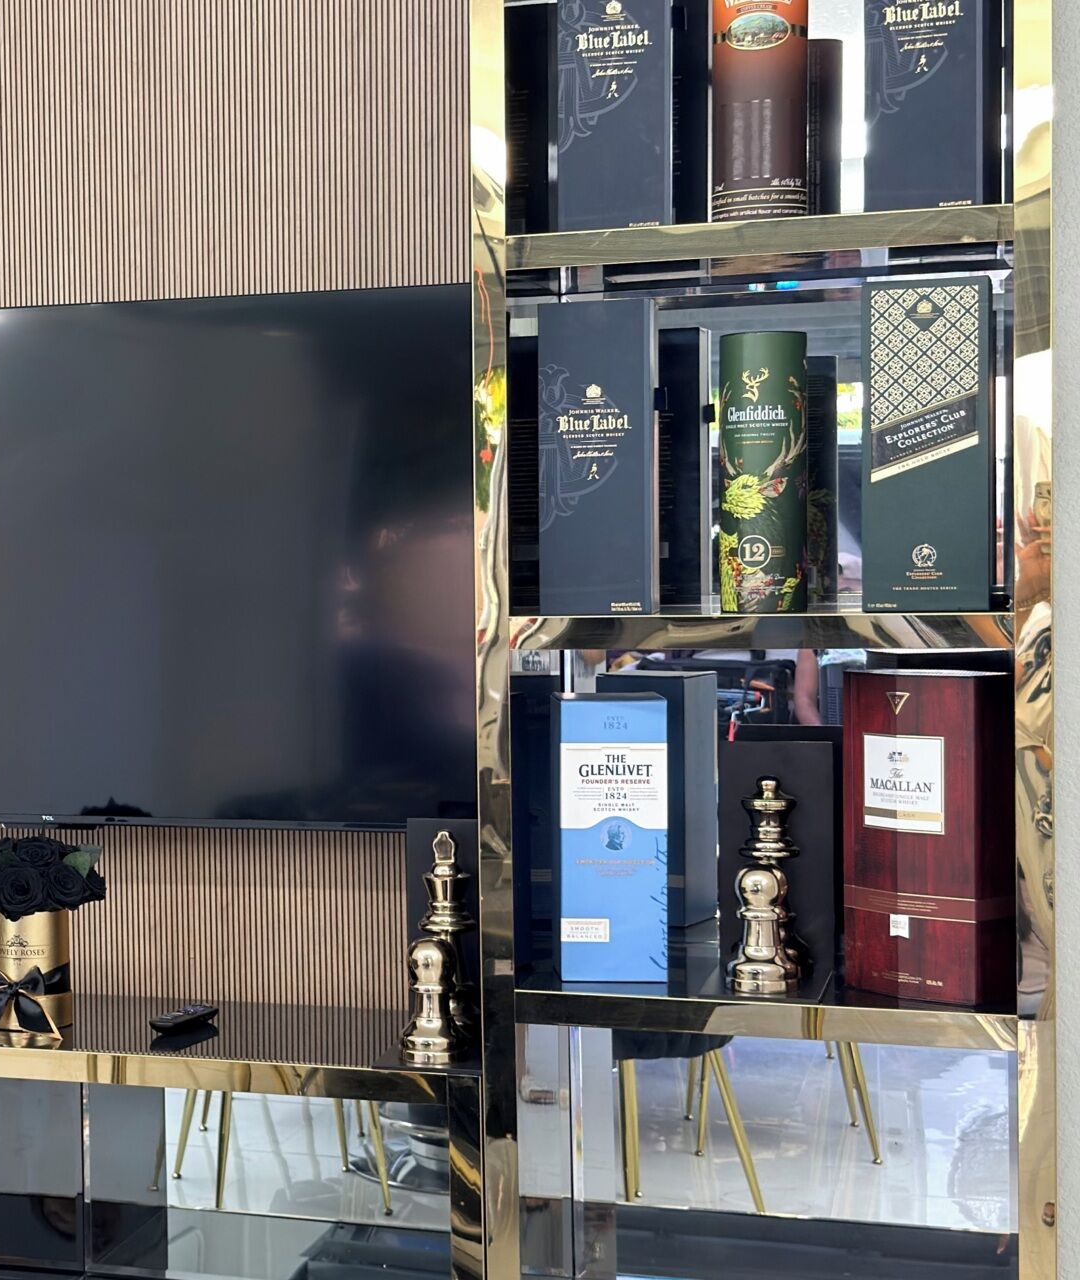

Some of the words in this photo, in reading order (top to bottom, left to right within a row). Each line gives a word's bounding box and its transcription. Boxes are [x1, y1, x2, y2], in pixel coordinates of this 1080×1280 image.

[882, 5, 919, 25] Blue
[575, 32, 610, 52] Blue
[727, 404, 785, 422] Glenfiddich
[940, 409, 967, 424] CLUB
[556, 415, 591, 433] Blue
[900, 417, 924, 430] JOHNNIE
[897, 422, 954, 449] COLLECTION
[742, 542, 766, 562] 12
[603, 721, 628, 730] 1824
[605, 754, 626, 763] THE
[578, 764, 653, 777] GLENLIVET
[870, 778, 933, 793] MACALLAN
[605, 792, 627, 800] 1824
[20, 948, 46, 956] ROSES
